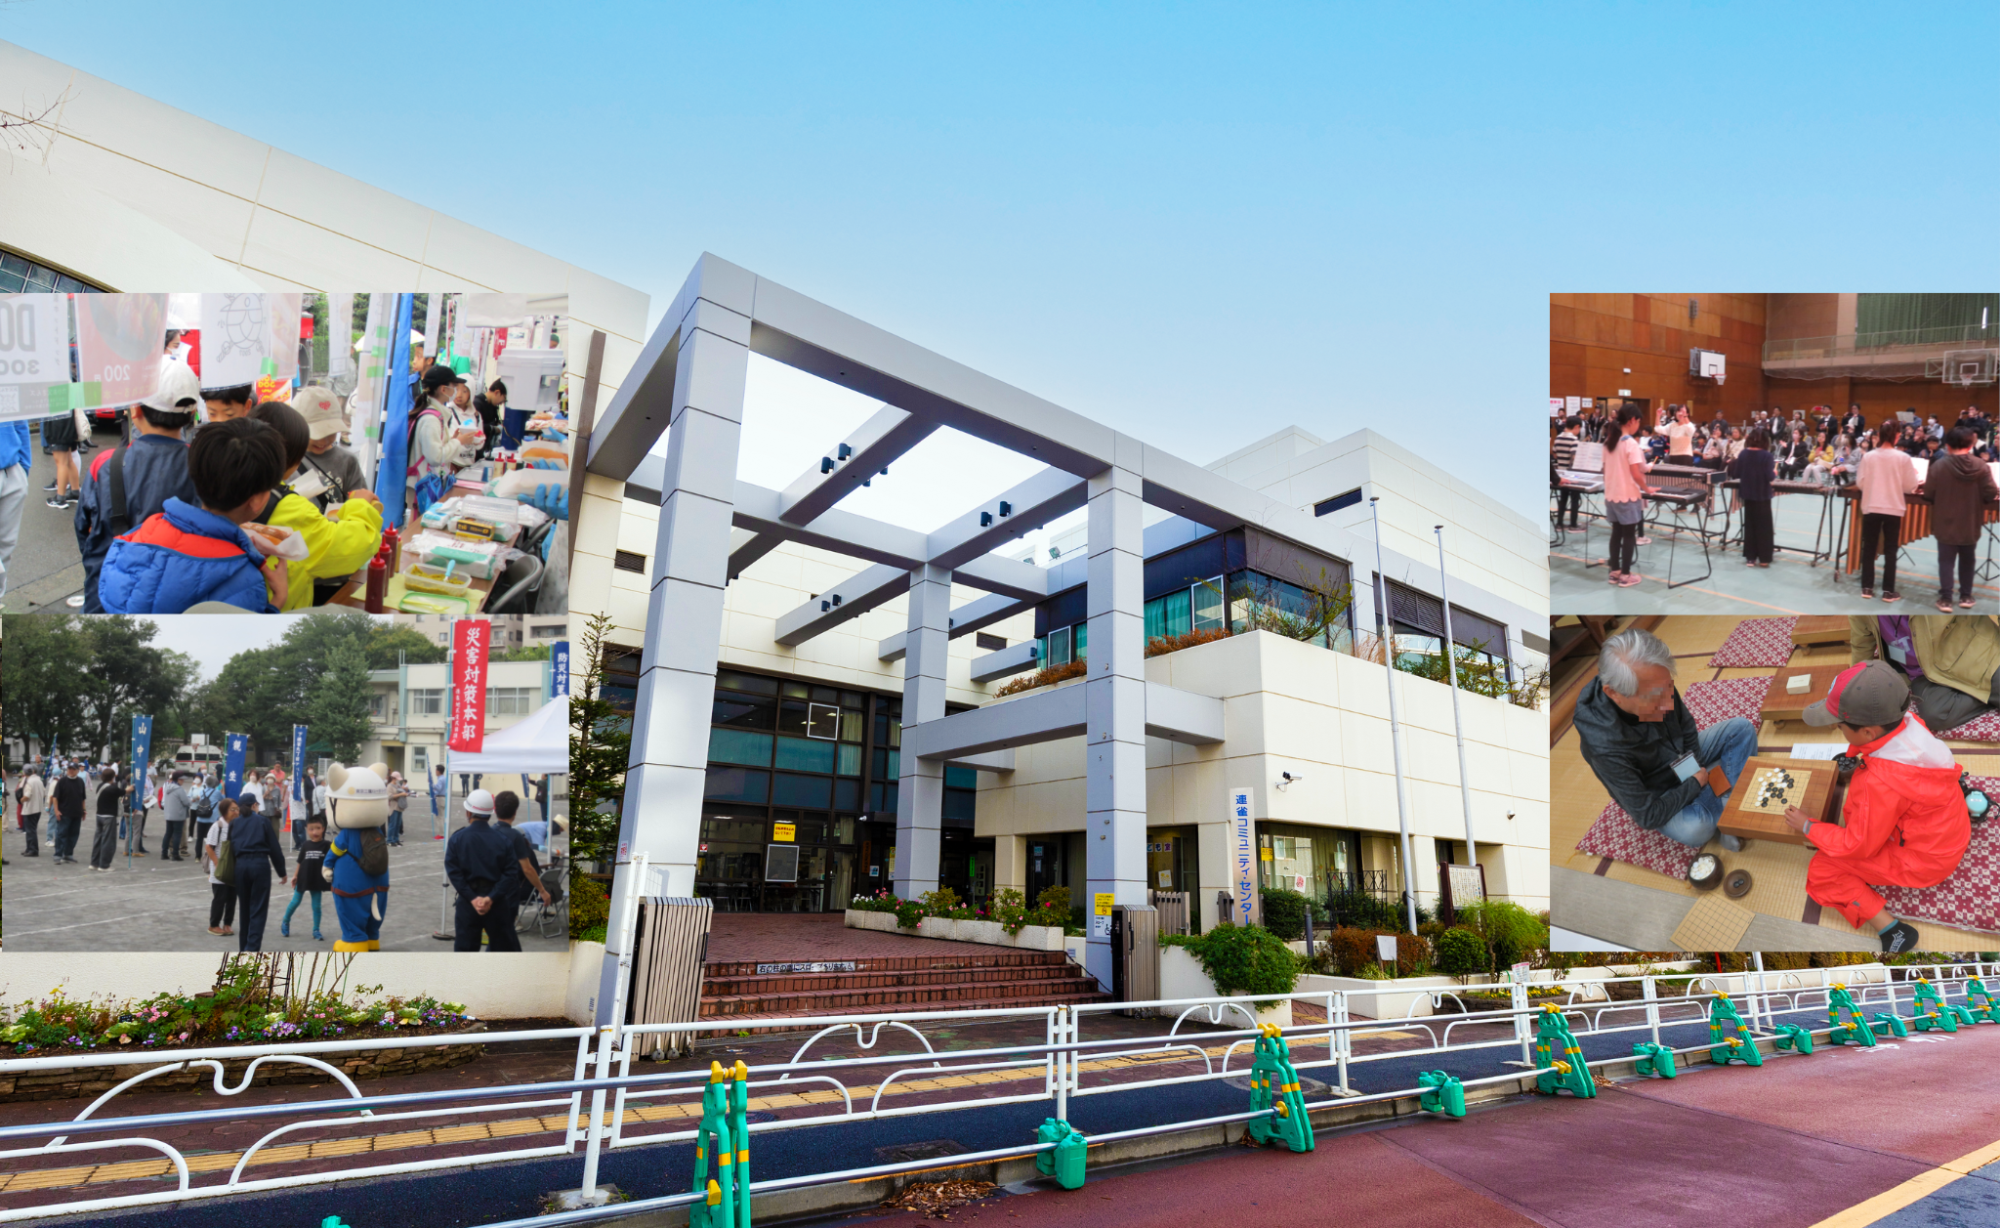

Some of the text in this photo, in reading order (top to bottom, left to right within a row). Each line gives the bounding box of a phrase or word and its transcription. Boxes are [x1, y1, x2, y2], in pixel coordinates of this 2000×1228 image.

[462, 627, 481, 742] 災害対策本部
[1235, 794, 1252, 925] 連雀コミュニティ・センター
